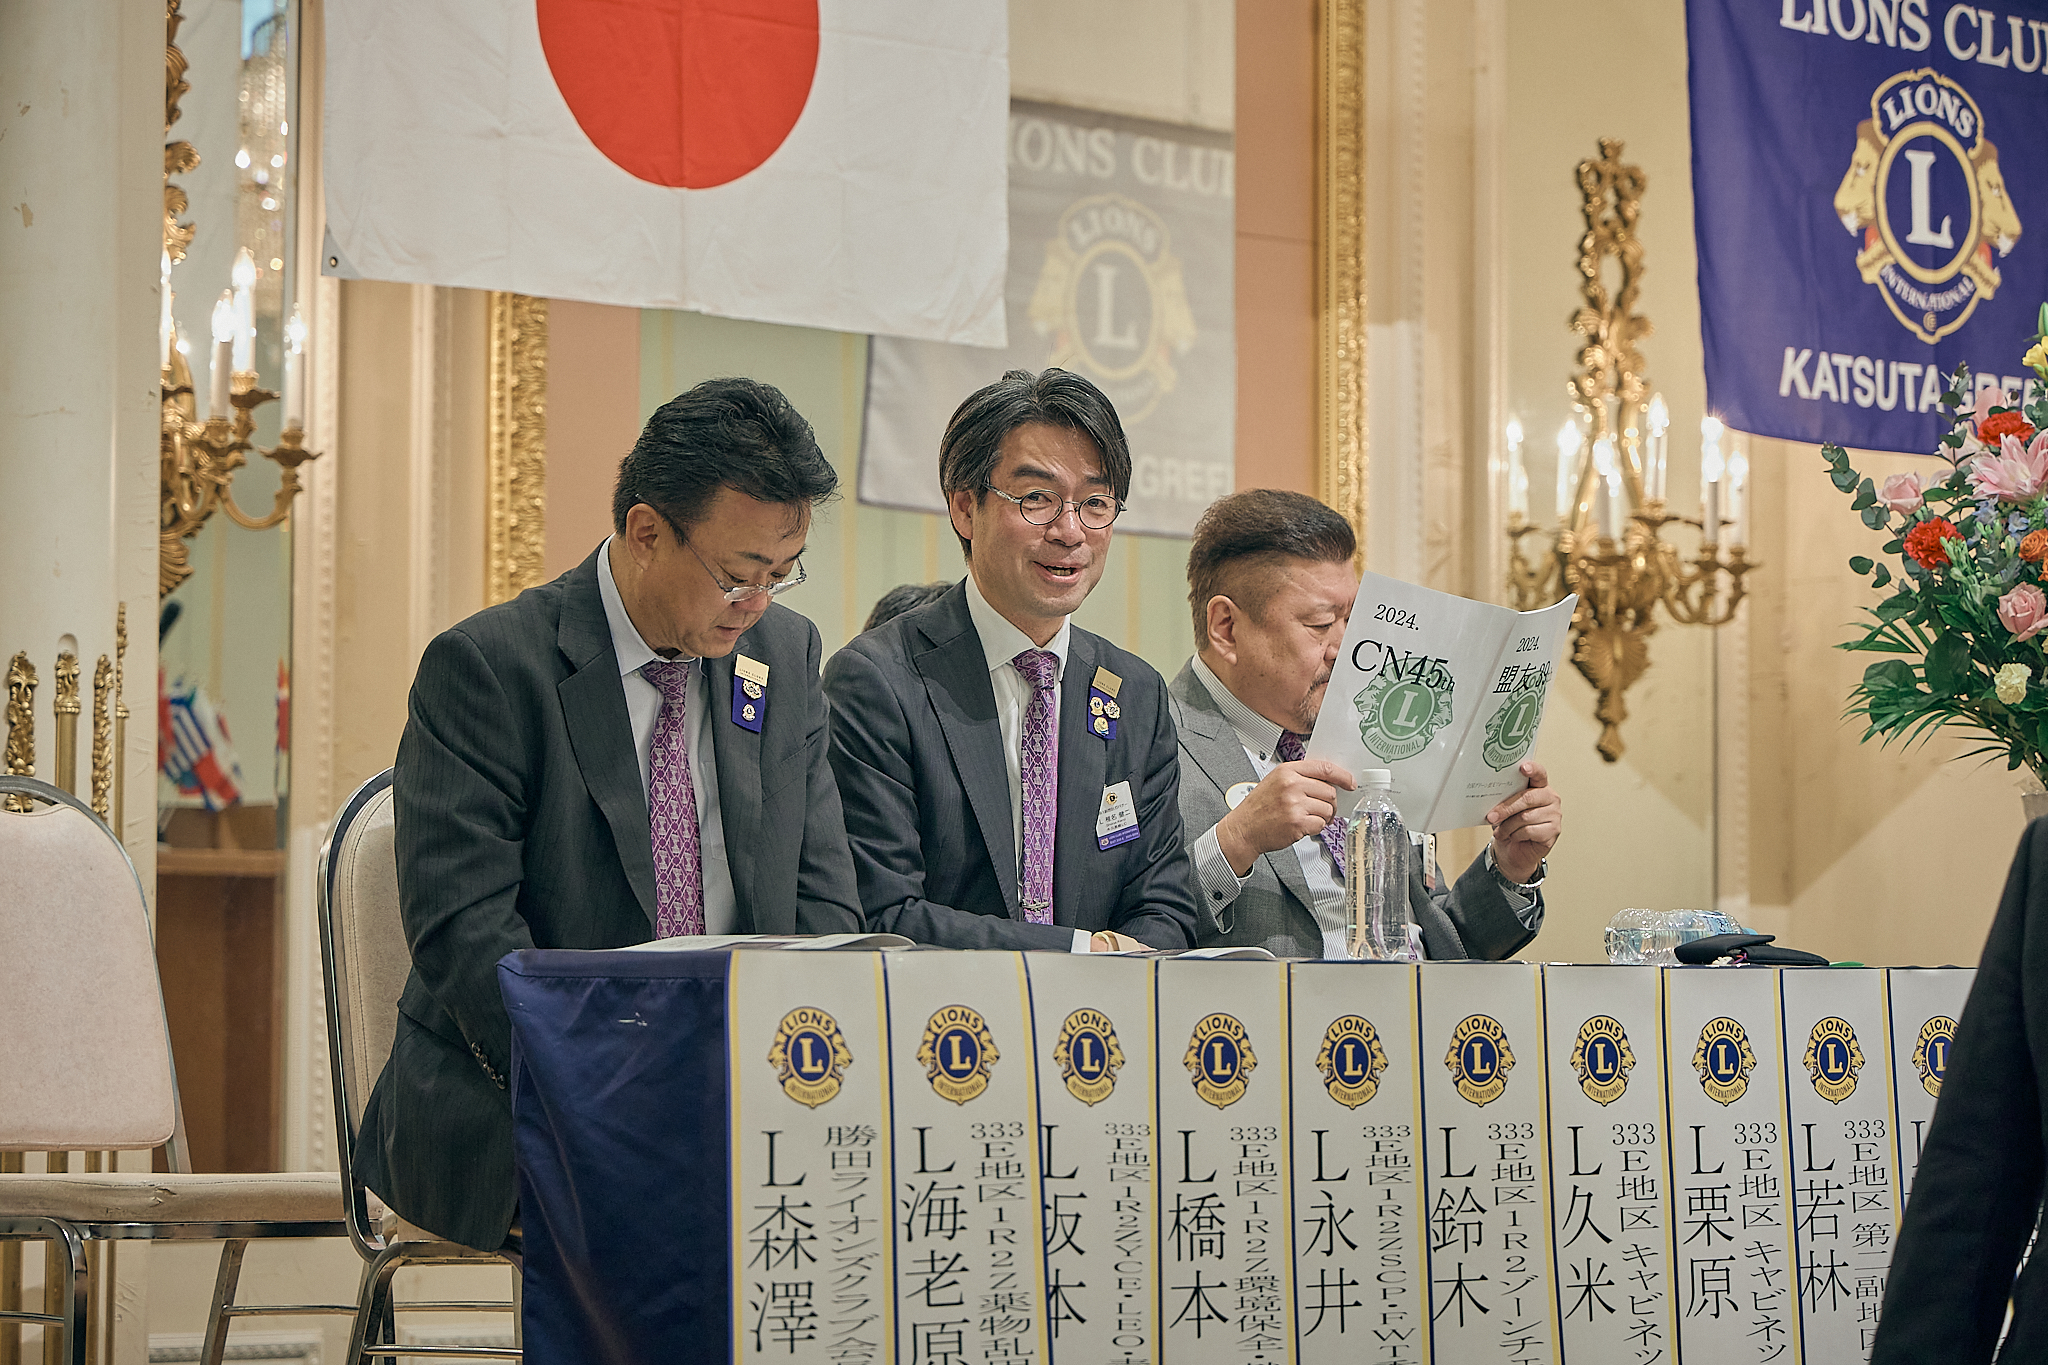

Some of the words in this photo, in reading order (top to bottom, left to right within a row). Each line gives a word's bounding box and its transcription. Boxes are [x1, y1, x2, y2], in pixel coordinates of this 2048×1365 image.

[1780, 0, 1932, 52] LIONS
[1944, 3, 2048, 75] CLU
[1882, 83, 1975, 138] LIONS
[1008, 116, 1117, 179] IONS
[1904, 149, 1954, 249] L
[1069, 206, 1156, 254] LIONS
[1880, 263, 1976, 312] INTERNATIONAL
[1094, 263, 1139, 349] L
[1779, 346, 1946, 414] KATSUTA
[1133, 453, 1229, 502] GREE
[1373, 604, 1420, 631] 2024.
[1351, 639, 1456, 692] CN45th
[1392, 690, 1419, 728] L
[1507, 703, 1530, 737] L
[1368, 731, 1421, 755] INTERNATIONAL
[785, 1011, 833, 1031] LIONS
[933, 1009, 980, 1029] LIONS
[1068, 1012, 1110, 1033] LIONS
[1198, 1017, 1241, 1036] LIONS
[1331, 1018, 1372, 1038] LIONS
[1459, 1018, 1500, 1037] LIONS
[1583, 1019, 1621, 1037] LIONS
[1705, 1020, 1742, 1039] LIONS
[1814, 1020, 1851, 1038] LIONS
[1924, 1019, 1959, 1037] LIONS
[798, 1037, 824, 1073] L
[947, 1035, 972, 1070] L
[1080, 1038, 1100, 1072] L
[1211, 1042, 1232, 1075] L
[1343, 1044, 1363, 1076] L
[1471, 1042, 1491, 1074] L
[1594, 1043, 1613, 1074] L
[1716, 1044, 1735, 1074] L
[1826, 1043, 1844, 1073] L
[1200, 1084, 1242, 1101] INTERNATIONAL
[1331, 1085, 1374, 1101] INTERNATIONAL
[1460, 1082, 1501, 1099] INTERNATIONAL
[1585, 1082, 1623, 1098] INTERNATIONAL
[1706, 1082, 1744, 1098] INTERNATIONAL
[1817, 1081, 1853, 1097] INTERNATIONAL
[1167, 1130, 1230, 1339] L橋本
[1302, 1129, 1363, 1337] L永井
[1430, 1126, 1491, 1328] L鈴木
[1562, 1125, 1616, 1323] L久米
[1683, 1124, 1739, 1320] L栗原
[1796, 1123, 1851, 1314] L若林
[747, 1130, 818, 1354] L森澤
[824, 1124, 880, 1365] 勝田ライオンズクラブ会
[901, 1126, 971, 1365] L海老原
[970, 1121, 1034, 1365] 333E地区1R2Z薬物乱
[1230, 1126, 1284, 1365] 333E地区1R2Z環境保全・
[1362, 1124, 1417, 1365] 333E地区1R2ZSCP・FWT
[1850, 1222, 1892, 1361] 第二副地区
